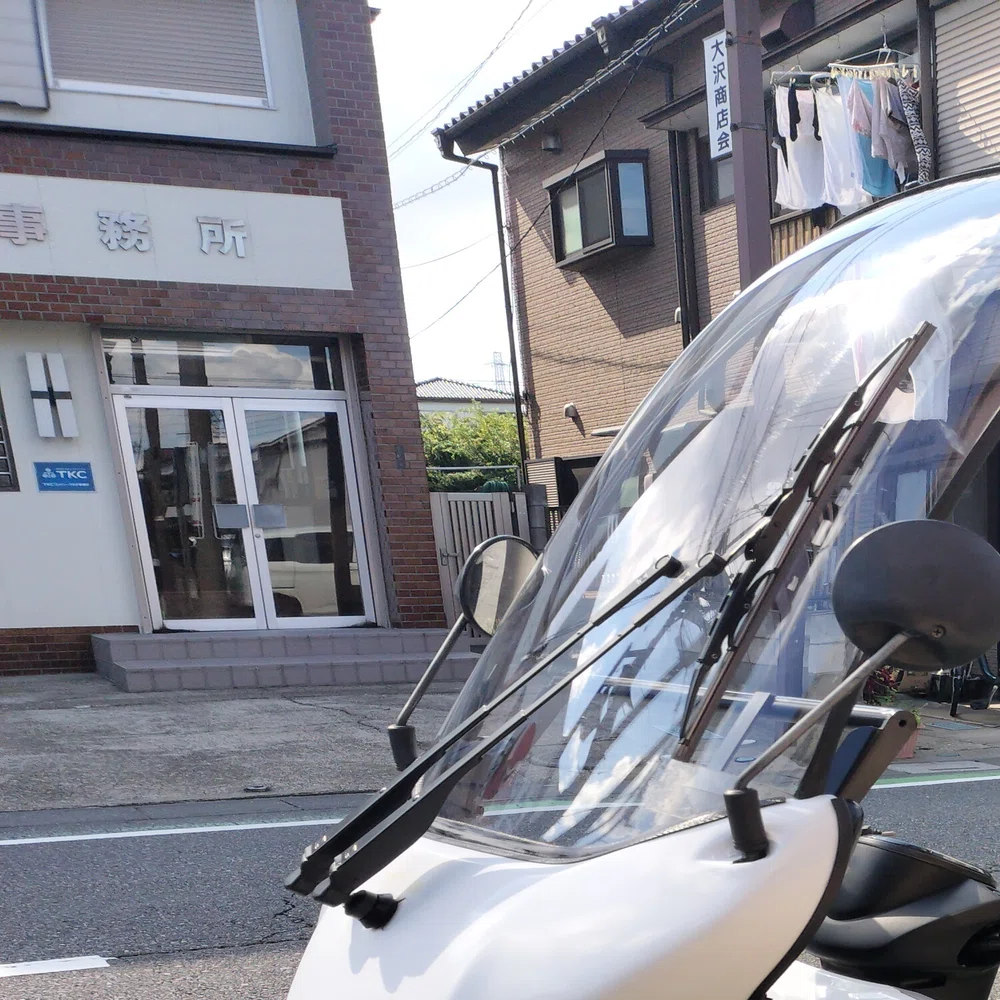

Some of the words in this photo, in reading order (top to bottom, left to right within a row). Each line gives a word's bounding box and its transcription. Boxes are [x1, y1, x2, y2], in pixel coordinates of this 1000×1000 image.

[711, 39, 730, 152] 大沢商店会
[0, 202, 248, 258] 事務所
[56, 470, 88, 479] TKC
